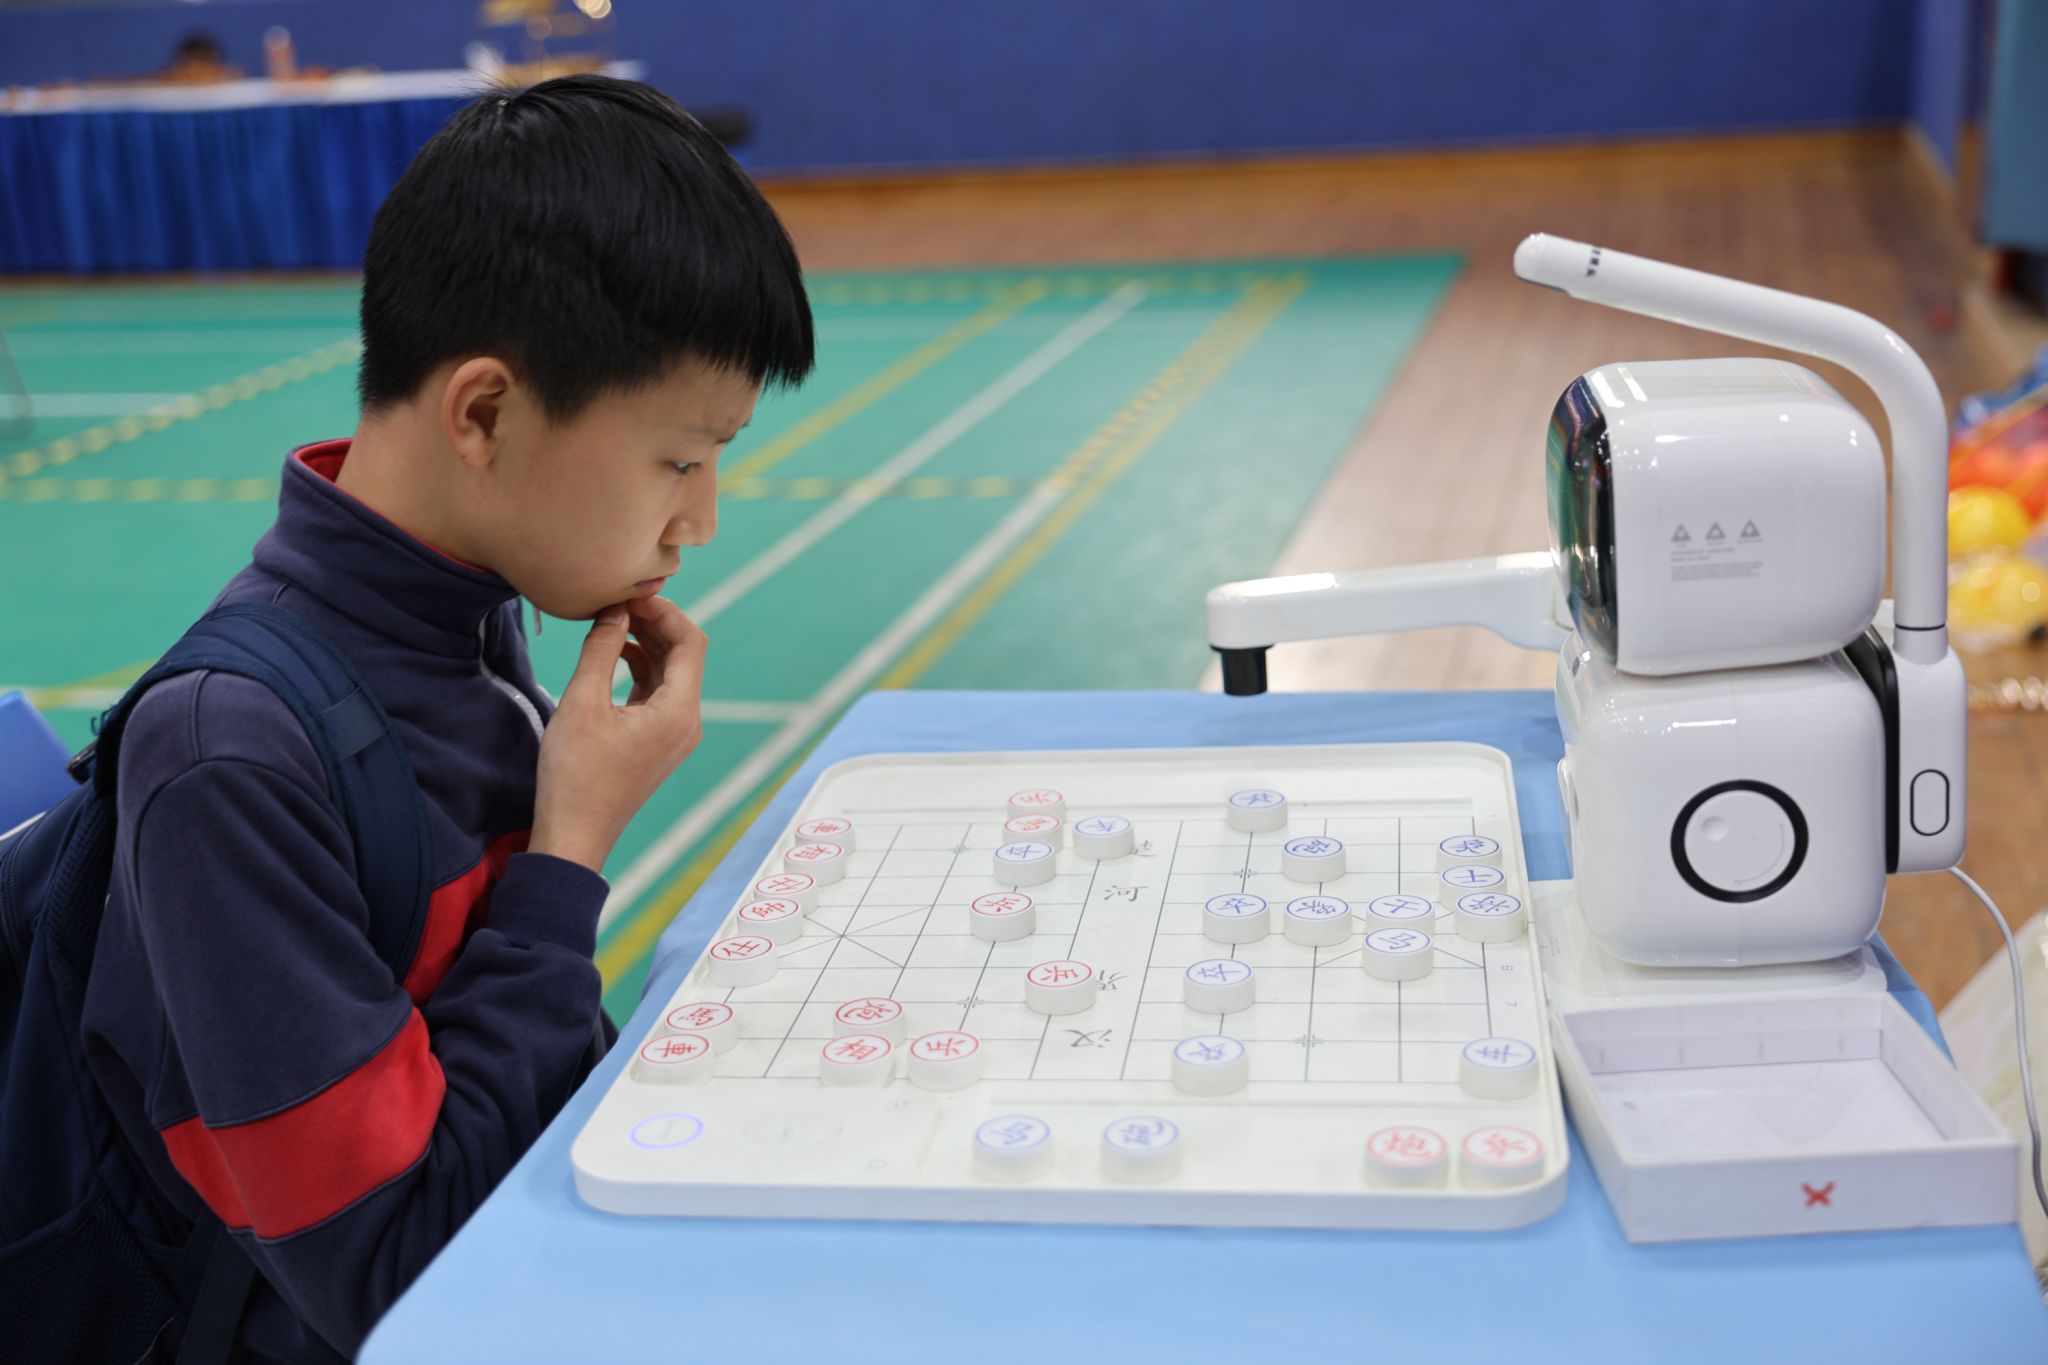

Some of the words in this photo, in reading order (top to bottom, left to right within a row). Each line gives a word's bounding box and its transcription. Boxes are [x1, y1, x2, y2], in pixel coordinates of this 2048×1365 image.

[767, 876, 804, 892] 仕
[1455, 869, 1492, 883] 士
[1103, 884, 1149, 902] 河
[983, 897, 1020, 913] 兵
[1382, 898, 1419, 914] 士
[721, 940, 760, 957] 仕
[1378, 932, 1417, 950] 马
[1040, 965, 1079, 983] 兵
[1197, 963, 1241, 982] 卒
[678, 1007, 718, 1026] 馬
[843, 1000, 892, 1021] 炮
[925, 1037, 966, 1057] 兵
[1063, 1027, 1113, 1049] 汉
[654, 1040, 697, 1058] 車
[836, 1038, 878, 1061] 相
